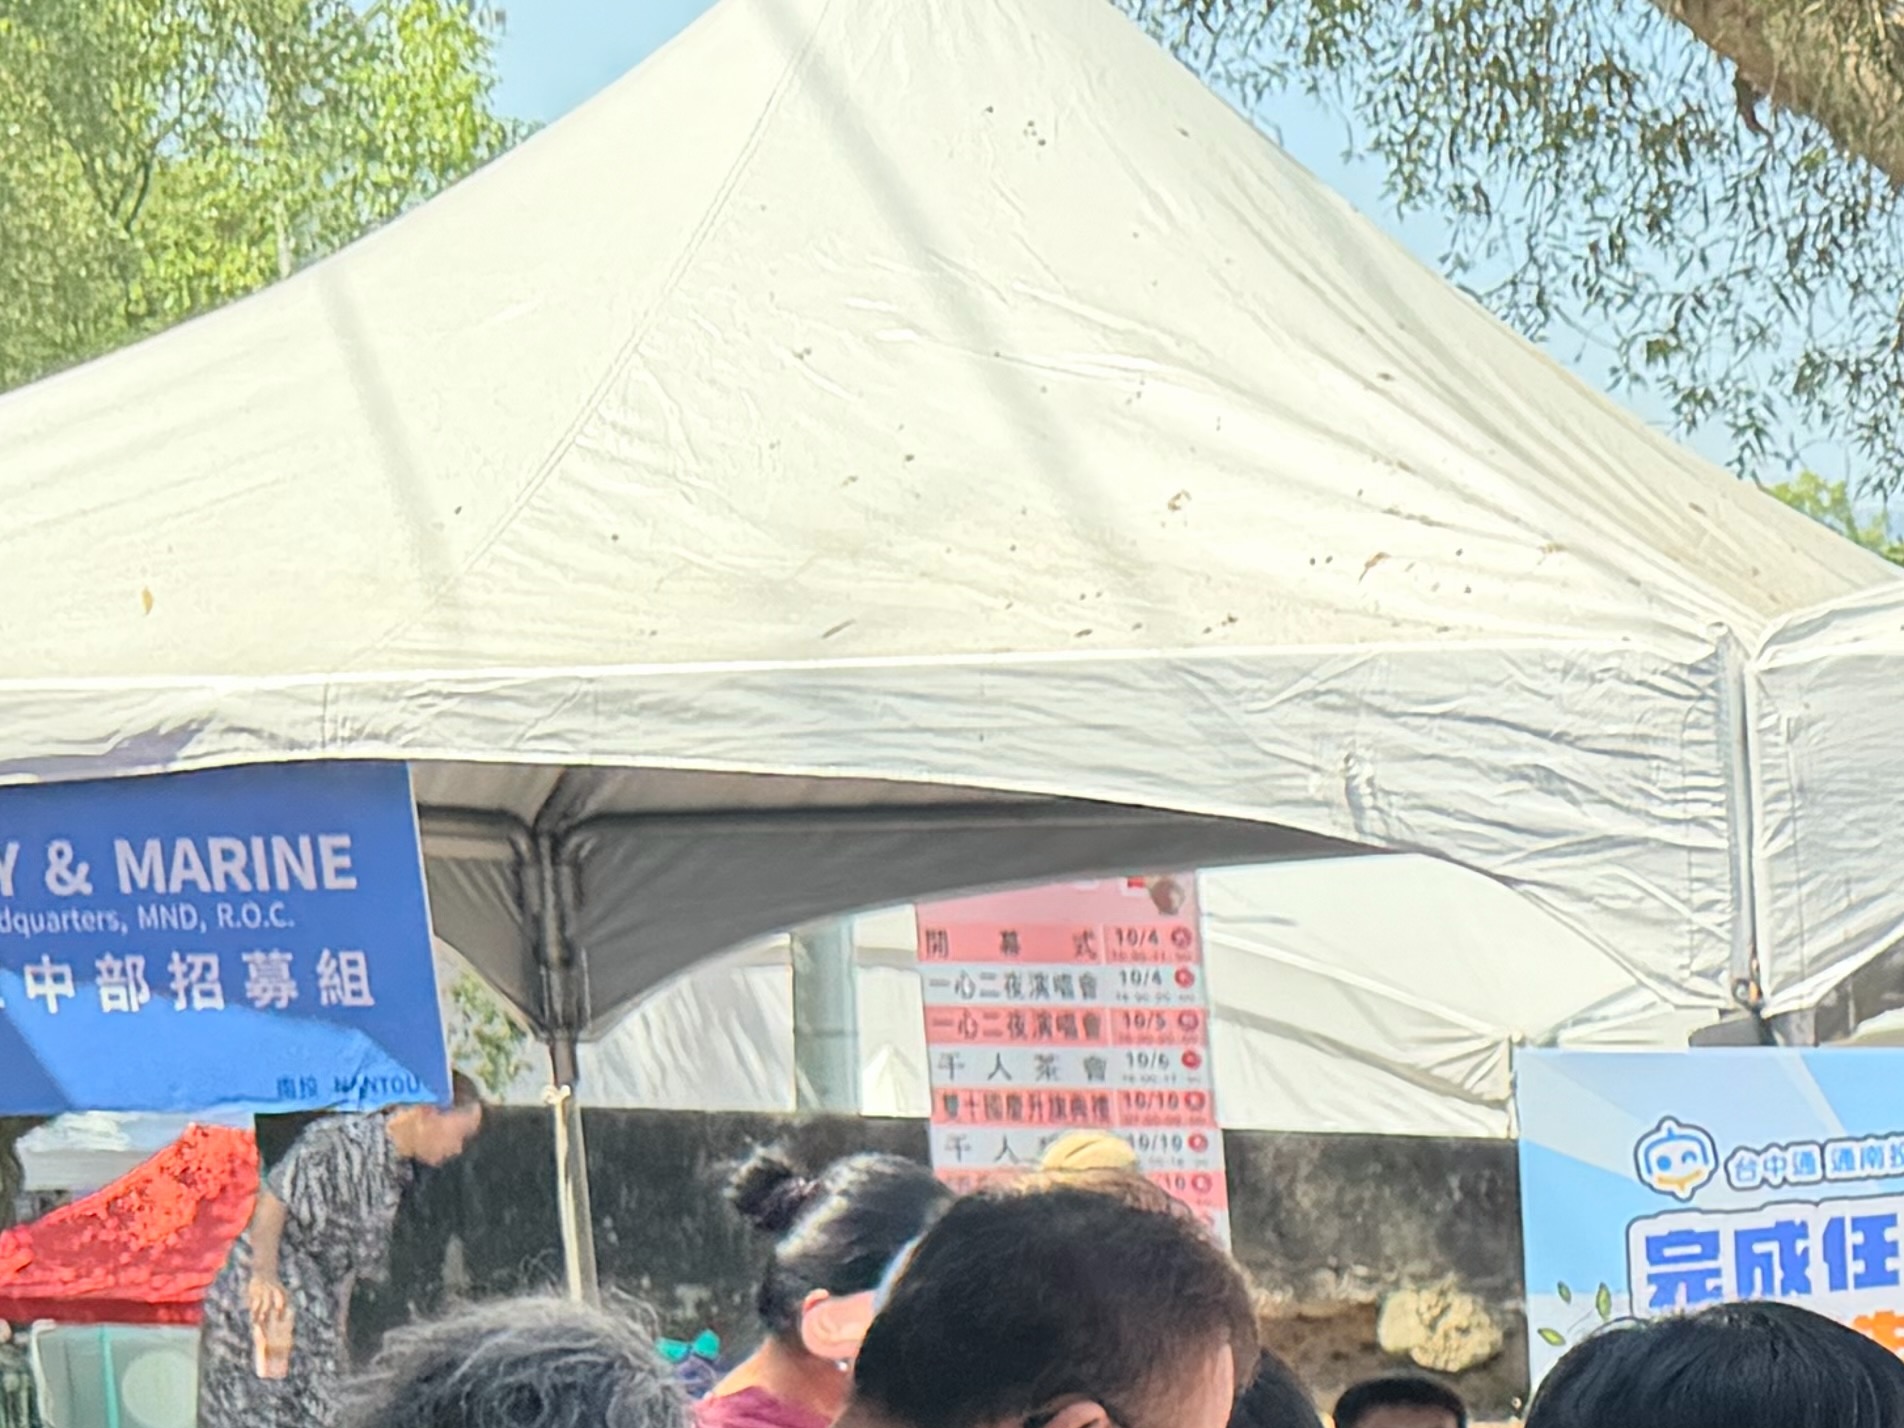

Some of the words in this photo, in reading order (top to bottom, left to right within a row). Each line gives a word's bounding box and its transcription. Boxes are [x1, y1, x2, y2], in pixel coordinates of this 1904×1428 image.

[45, 840, 93, 897] &
[114, 834, 358, 895] MARINE
[137, 903, 206, 934] MND,
[217, 901, 295, 929] R.O.C.
[23, 948, 375, 1014] 中部招募組
